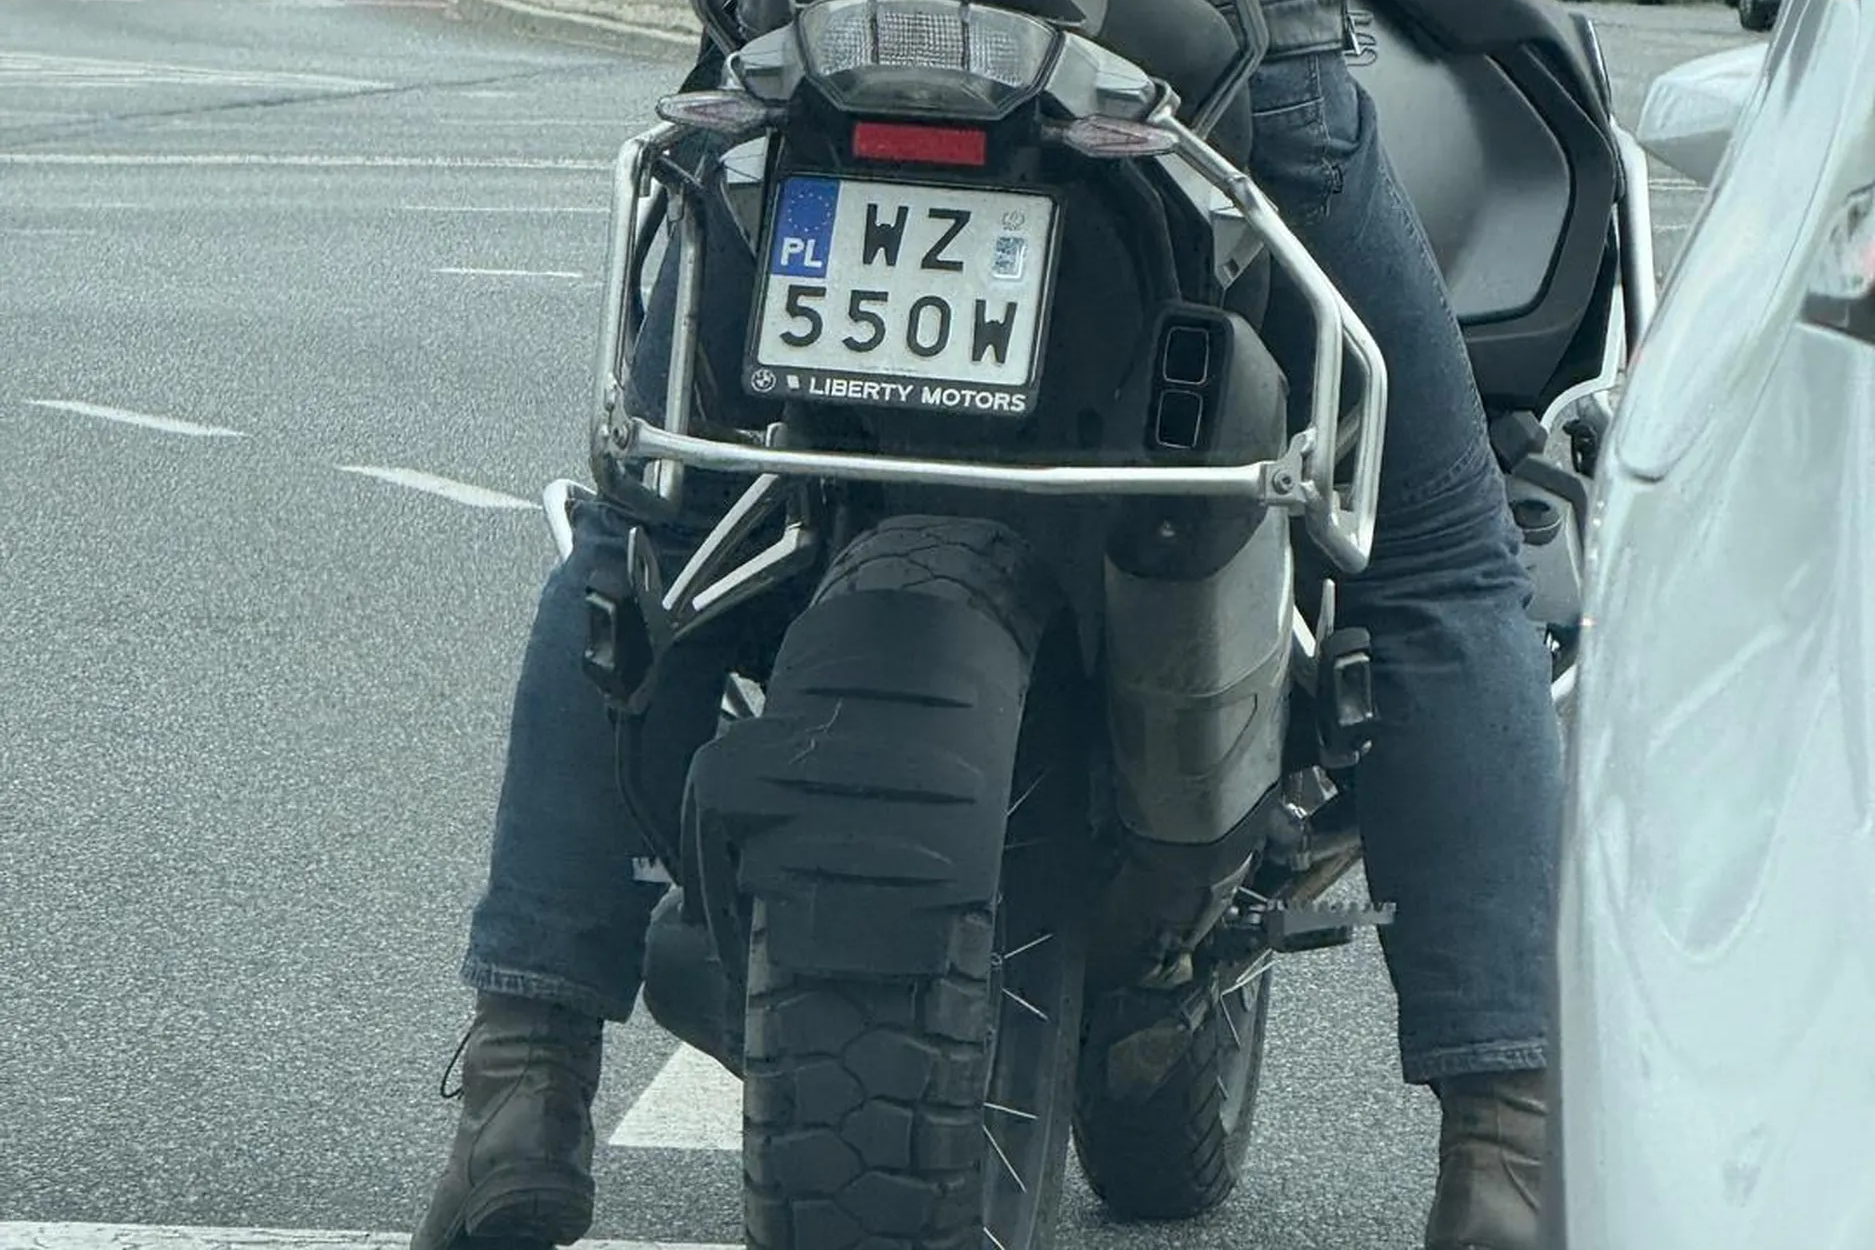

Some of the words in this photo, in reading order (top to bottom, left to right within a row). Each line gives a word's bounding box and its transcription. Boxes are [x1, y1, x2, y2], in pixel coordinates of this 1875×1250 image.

[780, 237, 823, 268] PL
[861, 202, 972, 272] WZ
[779, 283, 1019, 365] 550W
[809, 377, 913, 401] LIBERTY
[920, 386, 1026, 412] MOTORS
